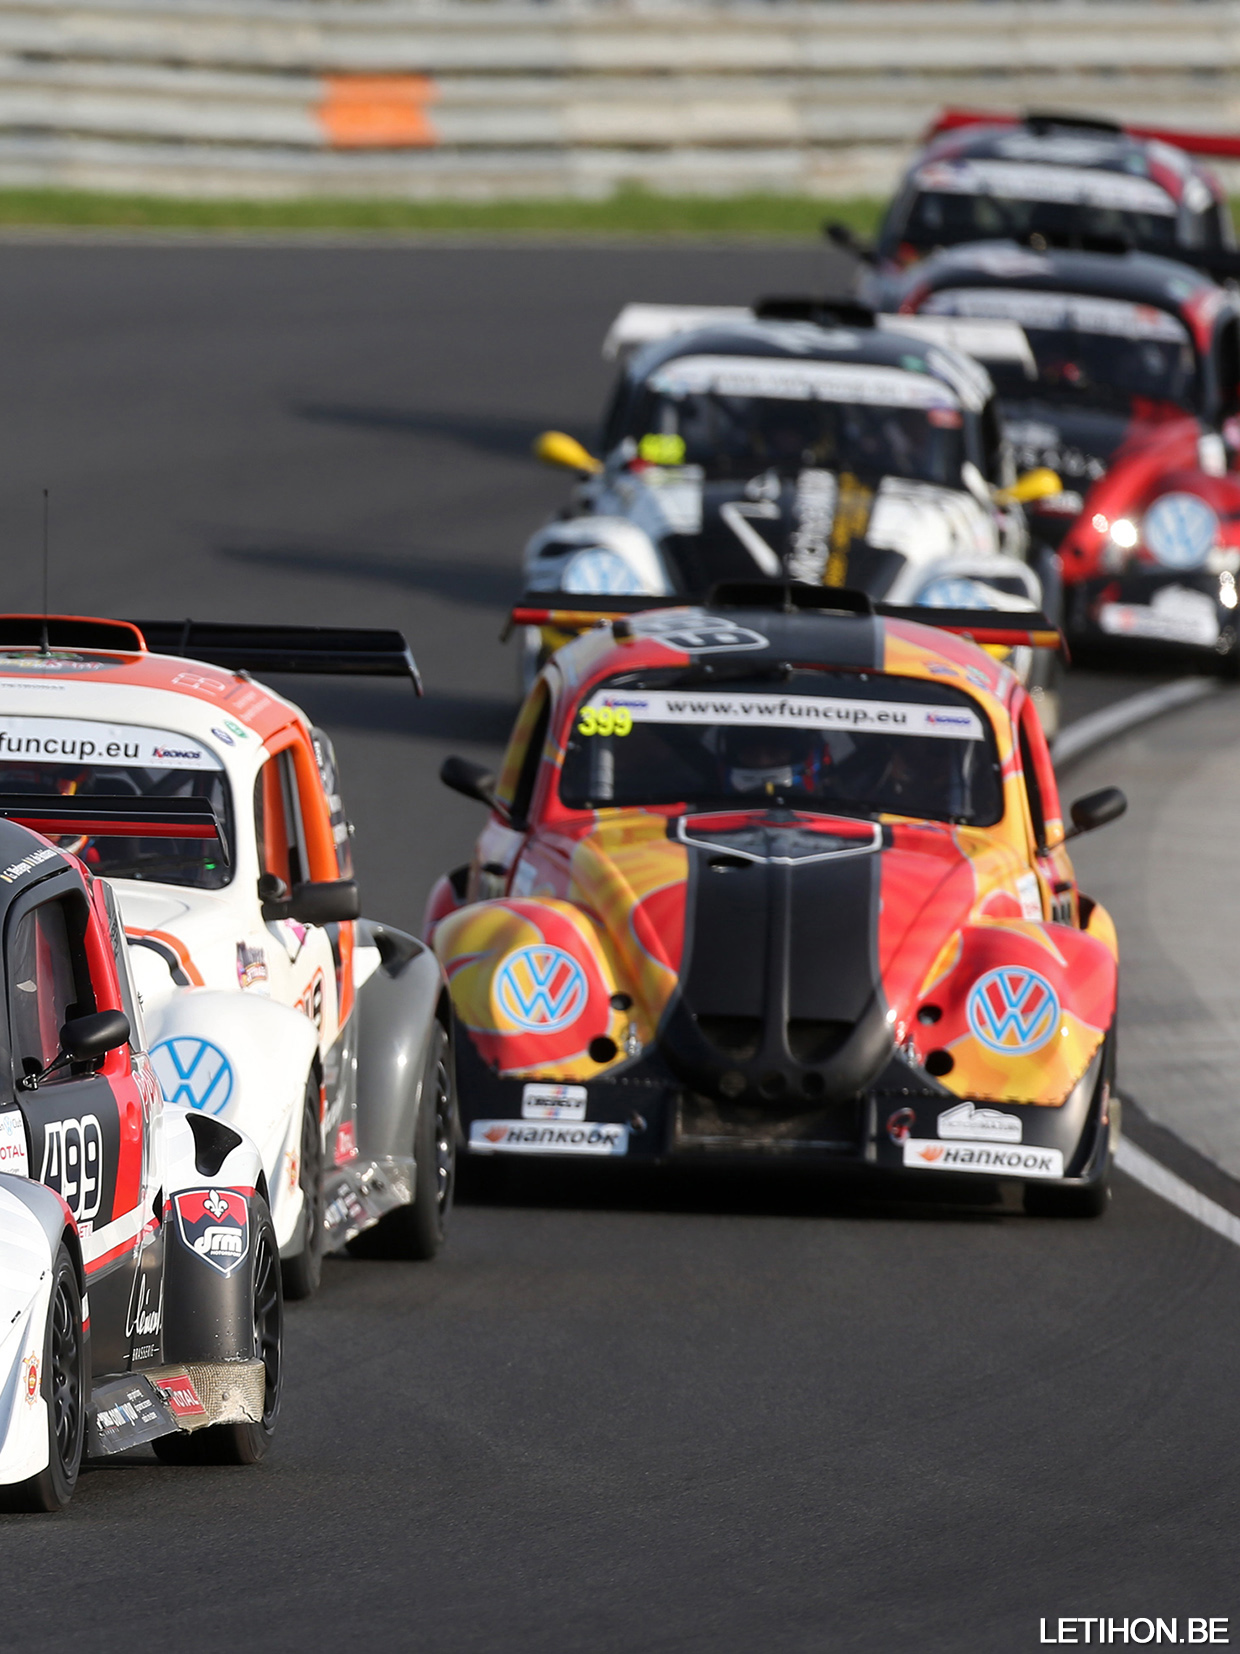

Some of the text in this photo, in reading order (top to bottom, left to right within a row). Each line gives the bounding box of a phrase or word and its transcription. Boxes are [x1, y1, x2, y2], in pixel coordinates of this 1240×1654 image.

[578, 706, 633, 737] 399
[666, 699, 908, 726] www.vwfuncup.eu
[40, 1114, 104, 1222] 499
